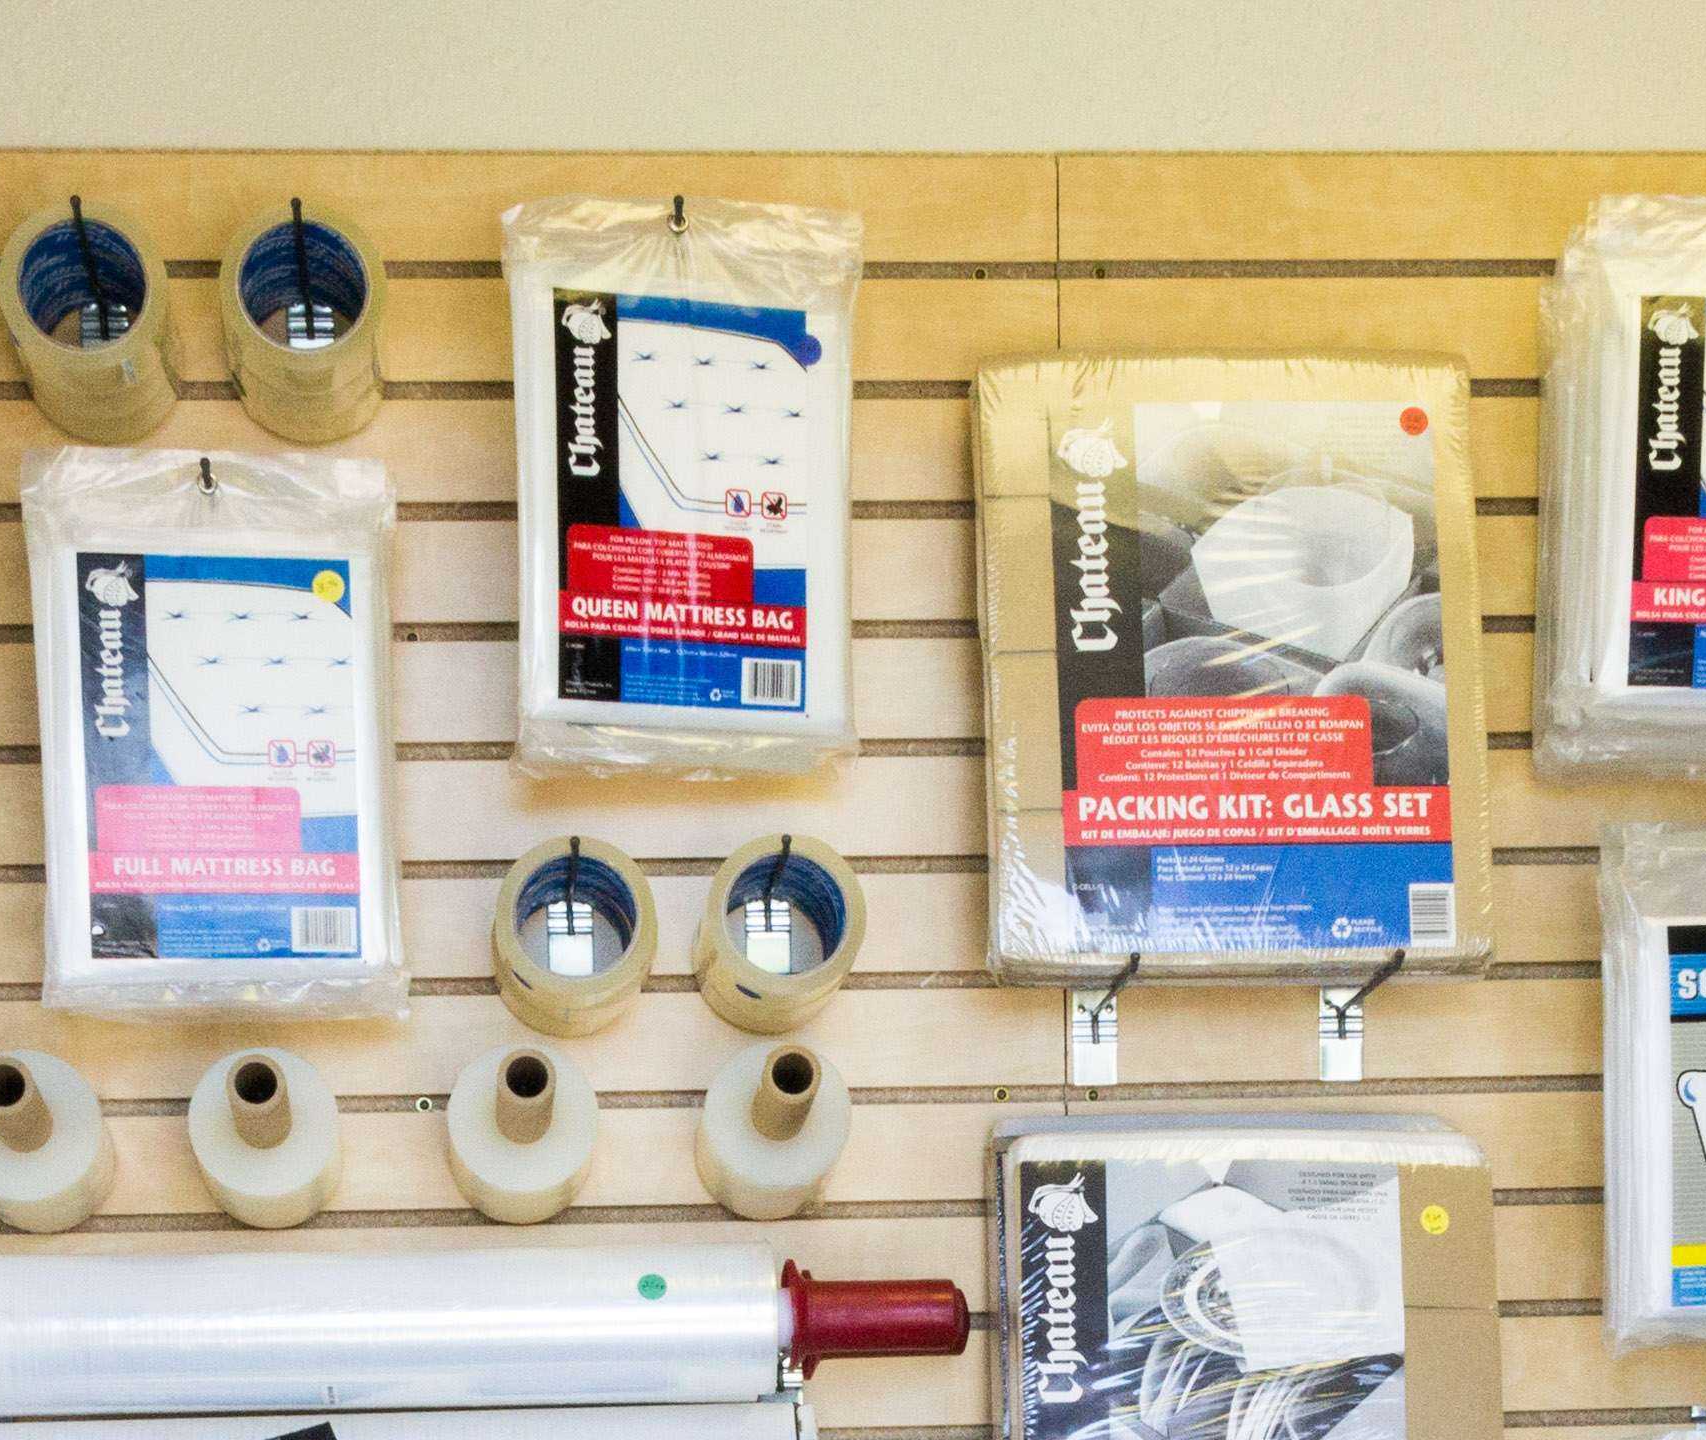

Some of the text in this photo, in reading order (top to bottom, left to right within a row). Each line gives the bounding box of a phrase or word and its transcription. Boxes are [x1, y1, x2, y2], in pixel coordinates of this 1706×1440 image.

[568, 343, 606, 478] Chateau
[1648, 342, 1684, 471] Chateau
[1071, 479, 1123, 654] Chateau
[1654, 589, 1706, 608] KING
[572, 596, 793, 629] QUEEN MATTRESS BAG
[94, 604, 130, 739] Chateau
[1115, 709, 1165, 719] PROTECTS
[1169, 708, 1211, 718] AGAINST
[1279, 708, 1329, 718] BREAKING
[1079, 792, 1431, 822] PACKING KIT: GLASS SET
[114, 857, 335, 878] FULL MATTRESS BAG
[1039, 1231, 1085, 1404] Chateau
